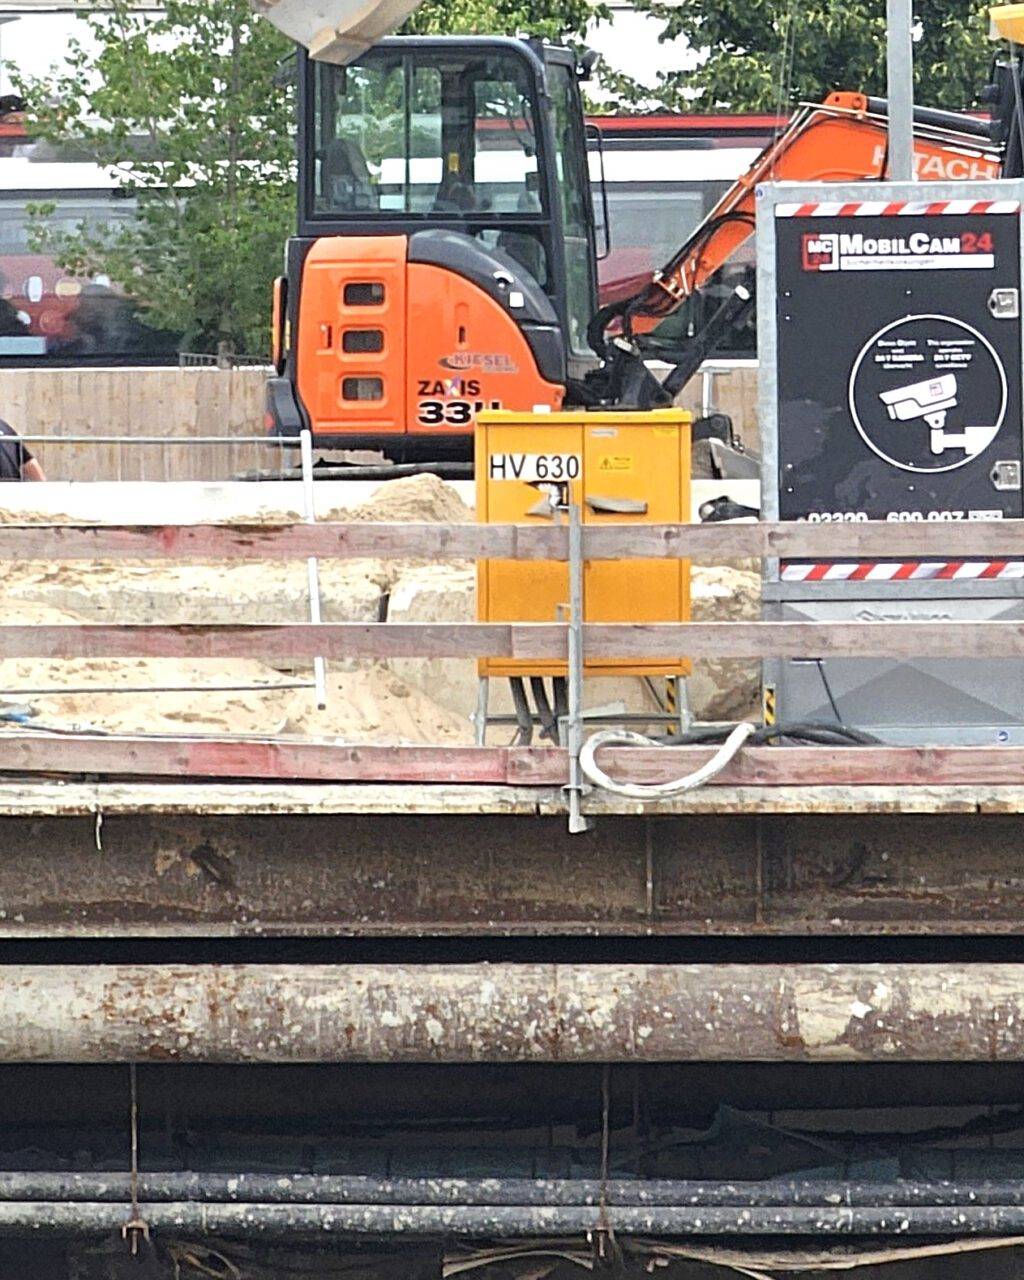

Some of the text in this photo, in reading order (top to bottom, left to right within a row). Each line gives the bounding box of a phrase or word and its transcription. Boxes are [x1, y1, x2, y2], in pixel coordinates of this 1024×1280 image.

[454, 354, 510, 366] KIESEL
[418, 378, 481, 397] ZAXIS
[418, 401, 500, 424] 33
[490, 454, 579, 479] HV 630
